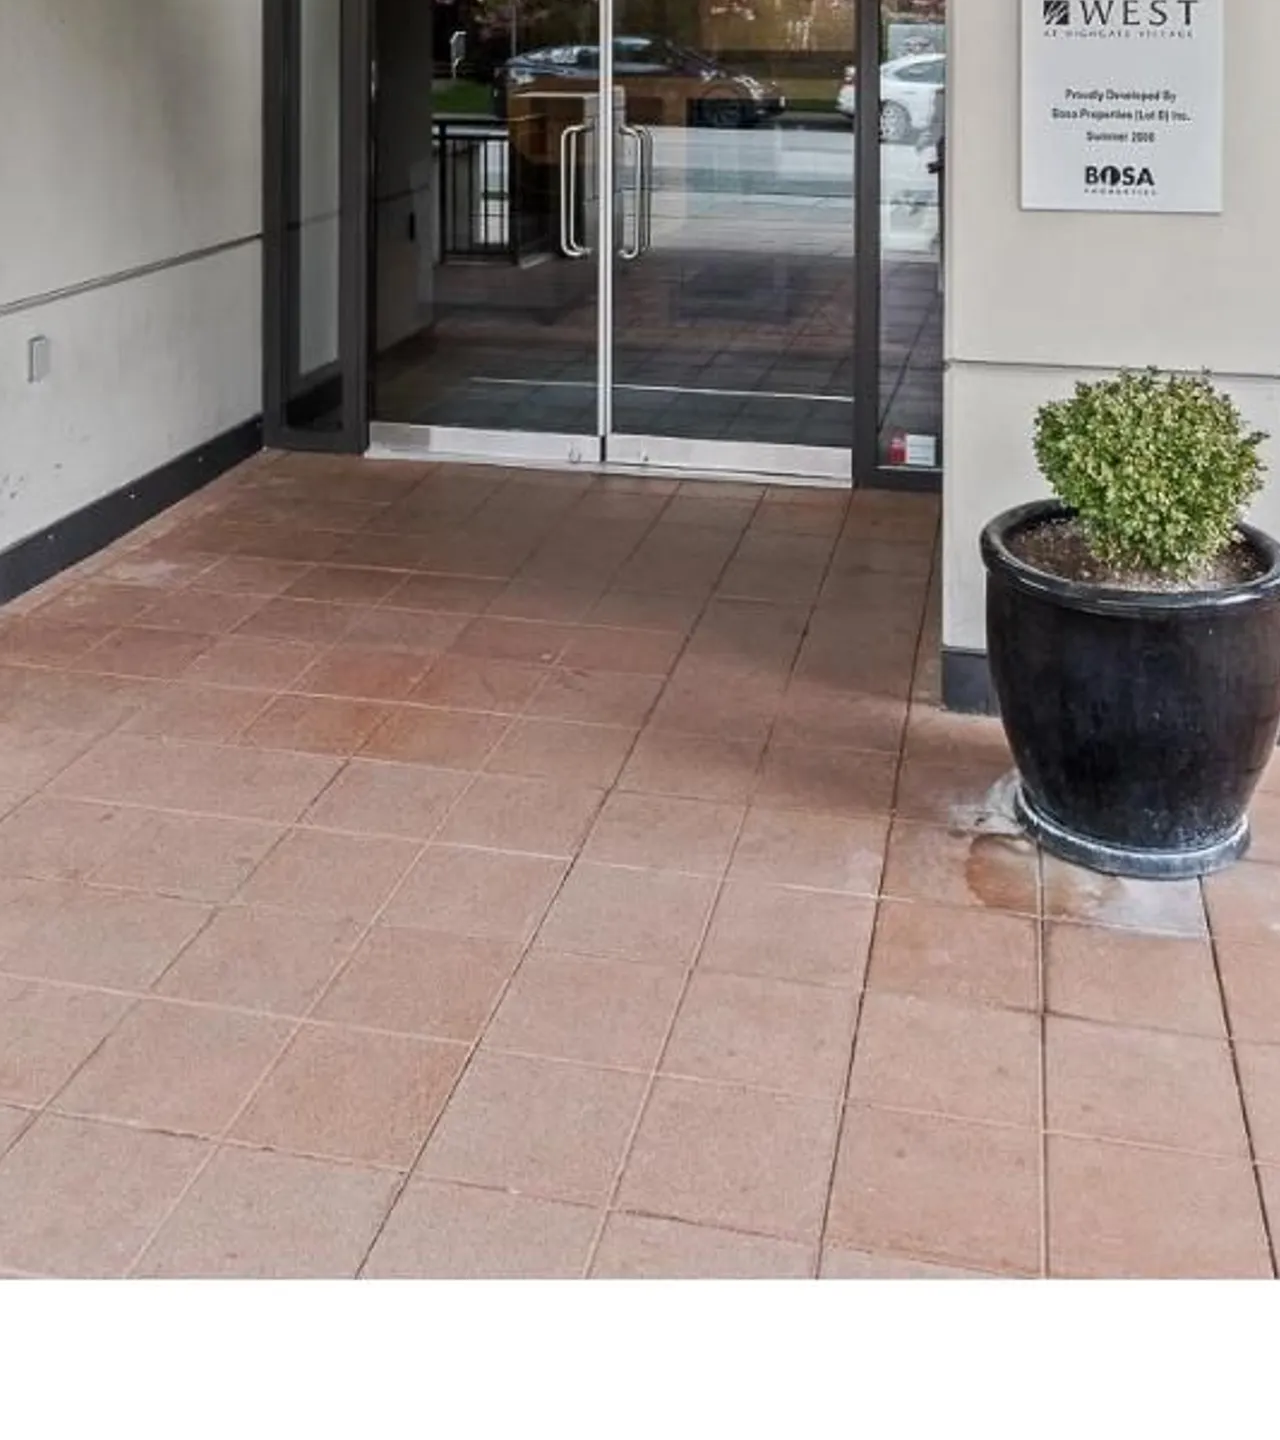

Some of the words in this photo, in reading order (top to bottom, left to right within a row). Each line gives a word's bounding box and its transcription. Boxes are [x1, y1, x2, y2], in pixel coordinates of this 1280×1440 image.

[1079, 0, 1199, 27] WEST
[1064, 88, 1104, 103] Proudly
[1106, 88, 1159, 102] Developed
[1084, 164, 1156, 187] BOSA
